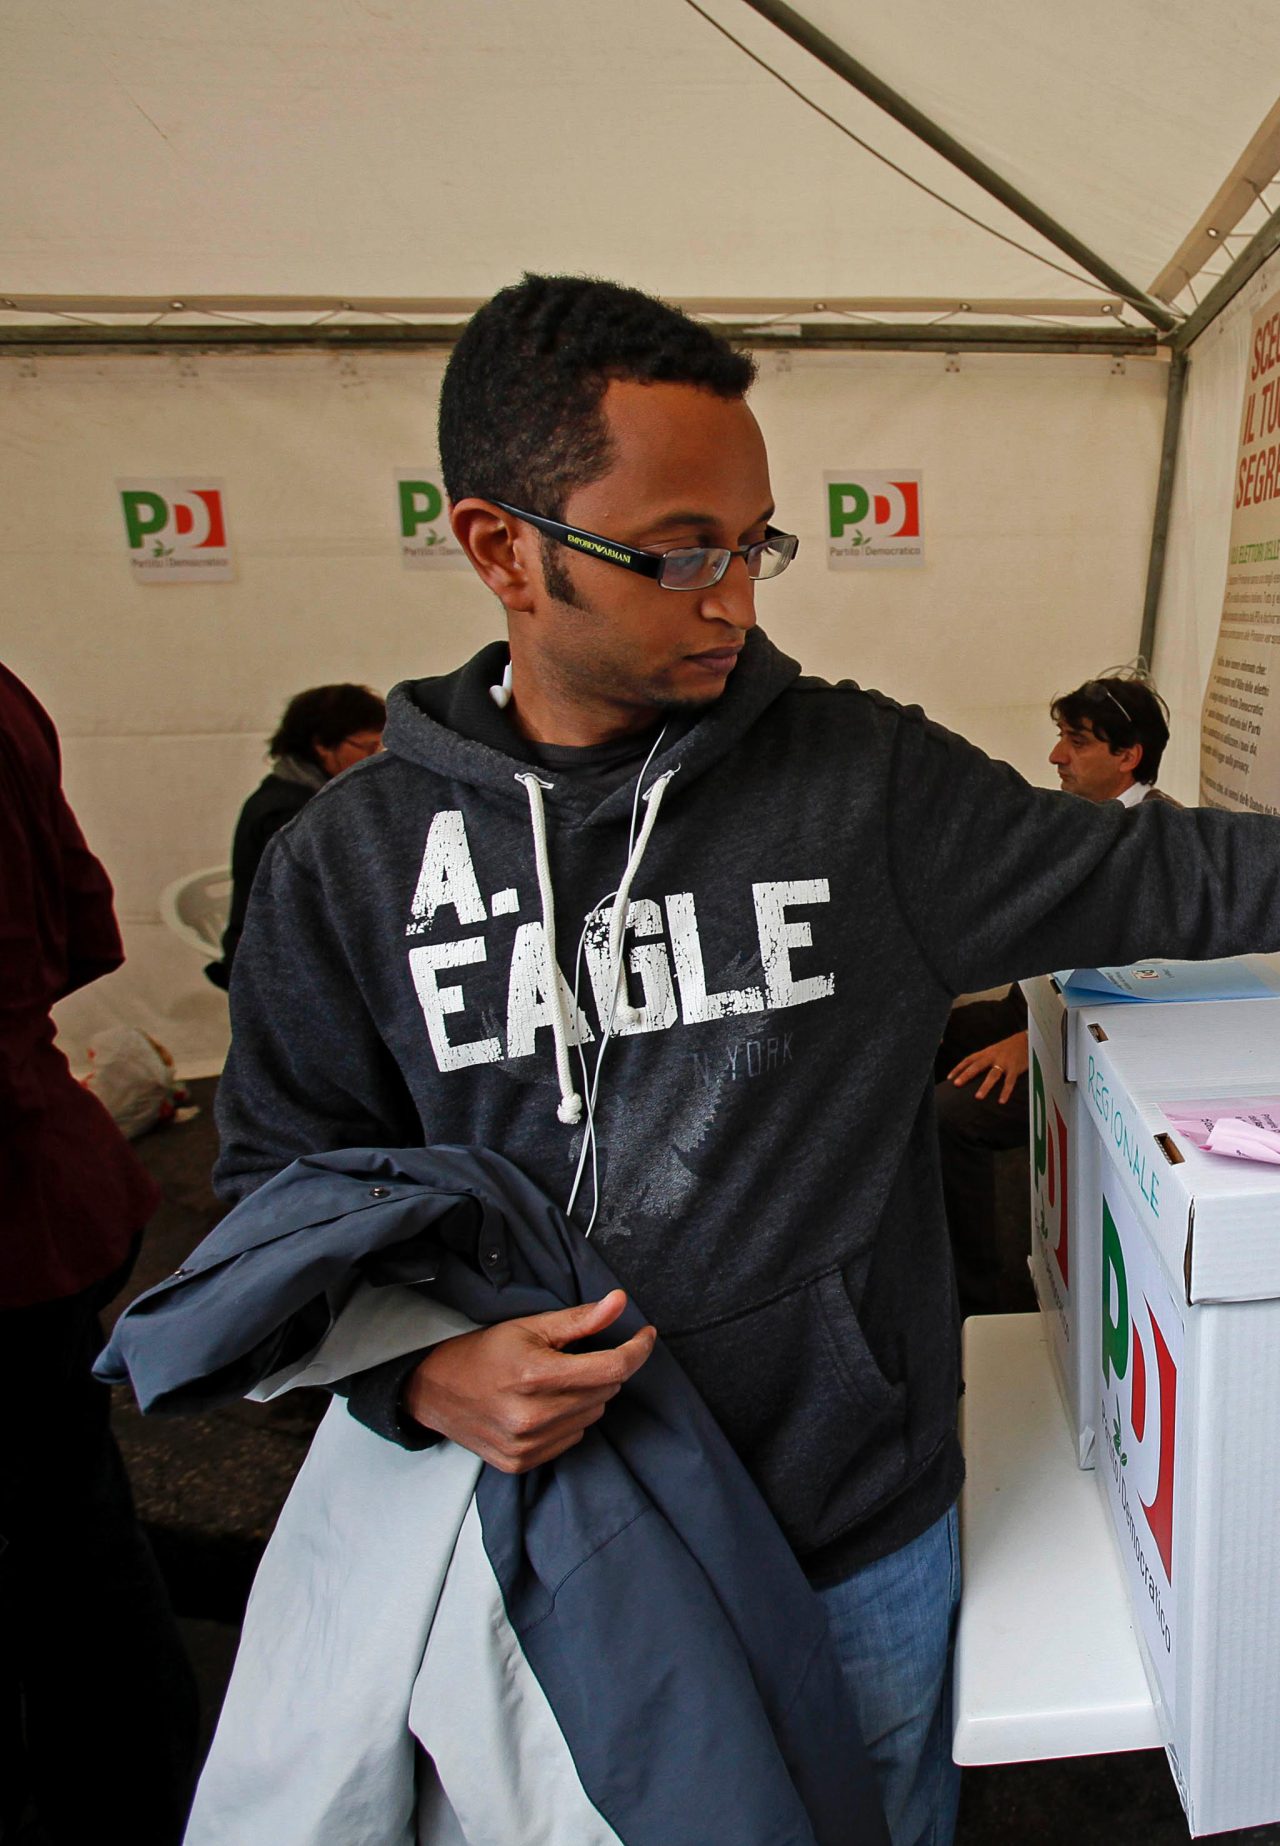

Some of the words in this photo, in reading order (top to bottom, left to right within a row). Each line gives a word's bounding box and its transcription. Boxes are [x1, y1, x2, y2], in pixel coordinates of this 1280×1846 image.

[1243, 396, 1258, 446] IL
[120, 490, 226, 549] PD
[568, 534, 594, 550] EMPORIO
[602, 548, 630, 563] ARMANI
[828, 481, 920, 538] PD
[830, 546, 860, 558] Partito
[864, 546, 920, 556] Democratico
[405, 810, 520, 936] A.
[408, 878, 836, 1073] EAGLE
[1088, 1055, 1160, 1219] REGIONALE
[1102, 1192, 1176, 1588] PD
[1101, 1400, 1118, 1482] Partito
[1121, 1475, 1170, 1654] Democratico
